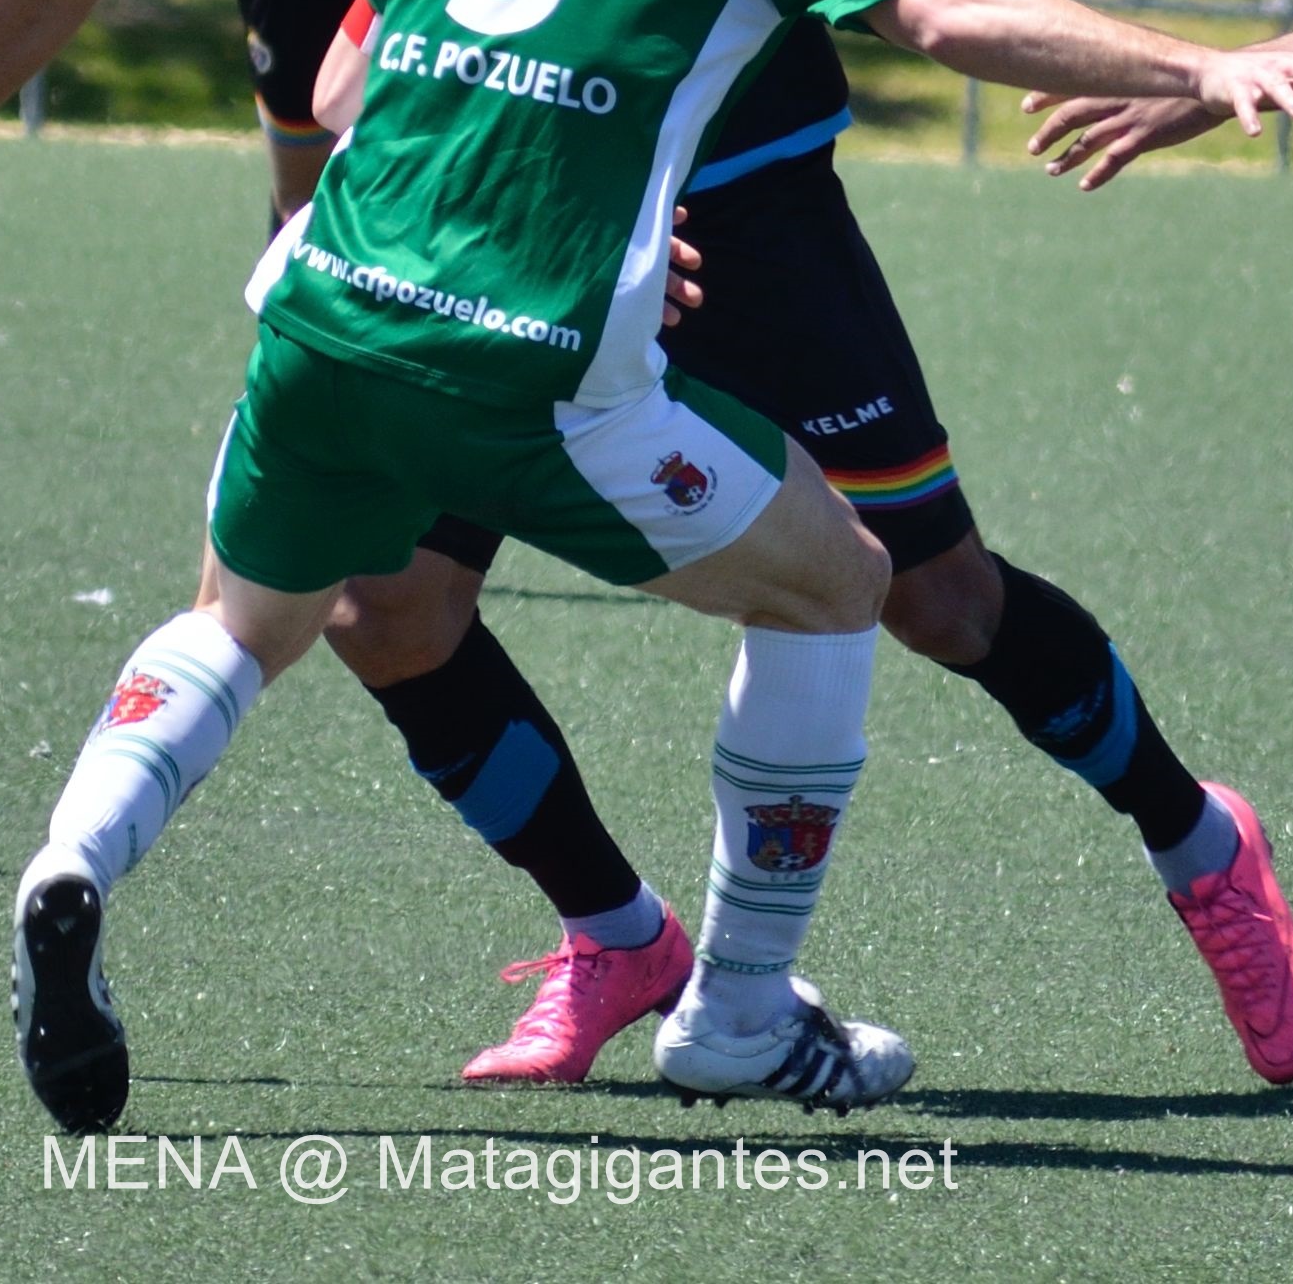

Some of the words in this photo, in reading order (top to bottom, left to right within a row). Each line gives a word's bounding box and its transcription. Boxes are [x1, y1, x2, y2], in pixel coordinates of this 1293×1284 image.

[380, 32, 427, 77] C.F.
[433, 41, 617, 114] POZUELO
[801, 396, 894, 435] KELME
